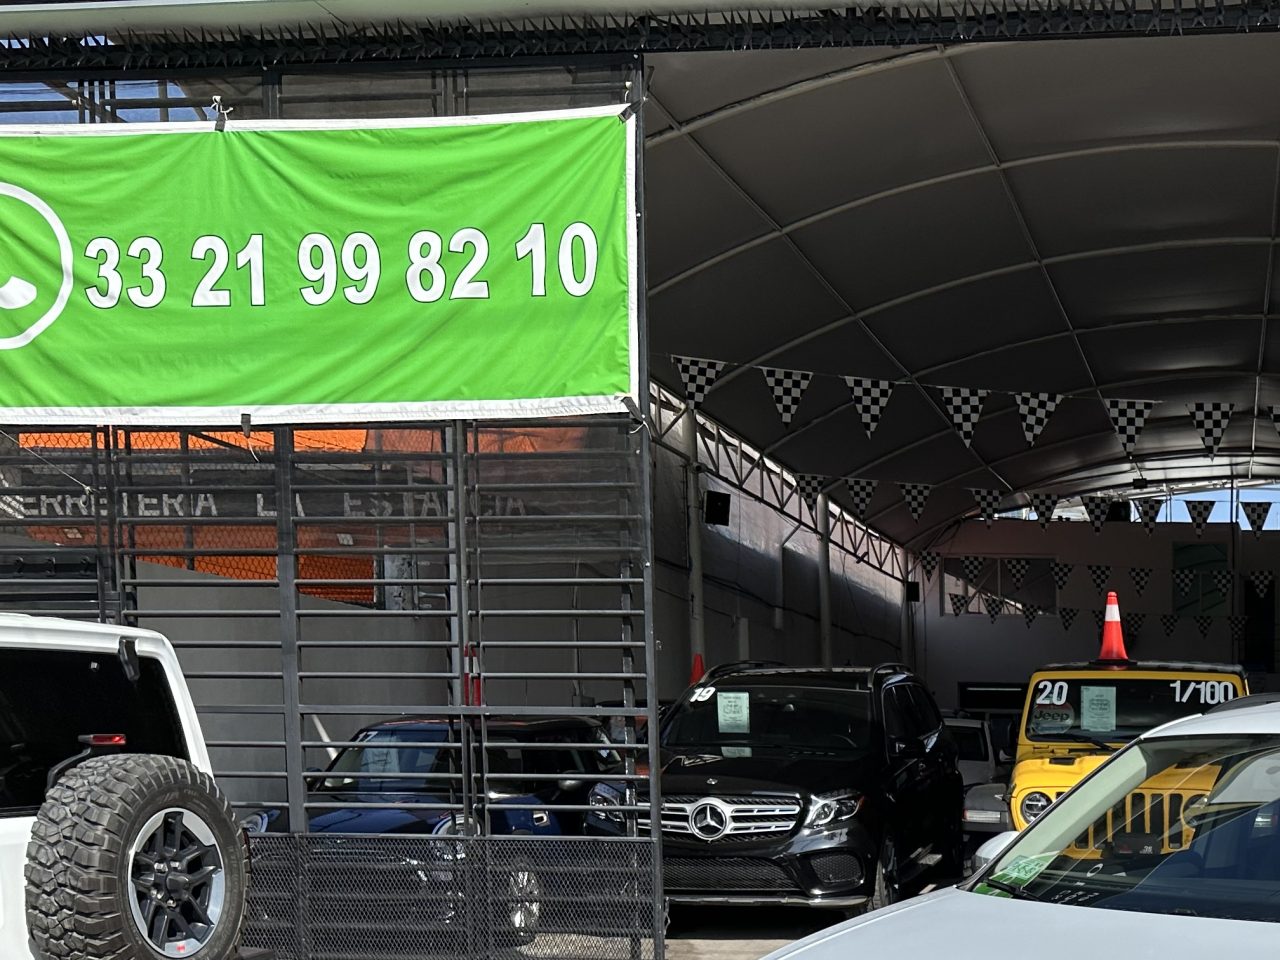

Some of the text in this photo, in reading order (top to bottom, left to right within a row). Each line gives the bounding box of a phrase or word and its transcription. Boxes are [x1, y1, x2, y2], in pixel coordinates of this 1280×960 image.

[84, 221, 599, 309] 33 21 99 82 10
[689, 686, 716, 702] 19
[1036, 680, 1234, 706] 20 1/100
[1034, 710, 1070, 723] Jeep
